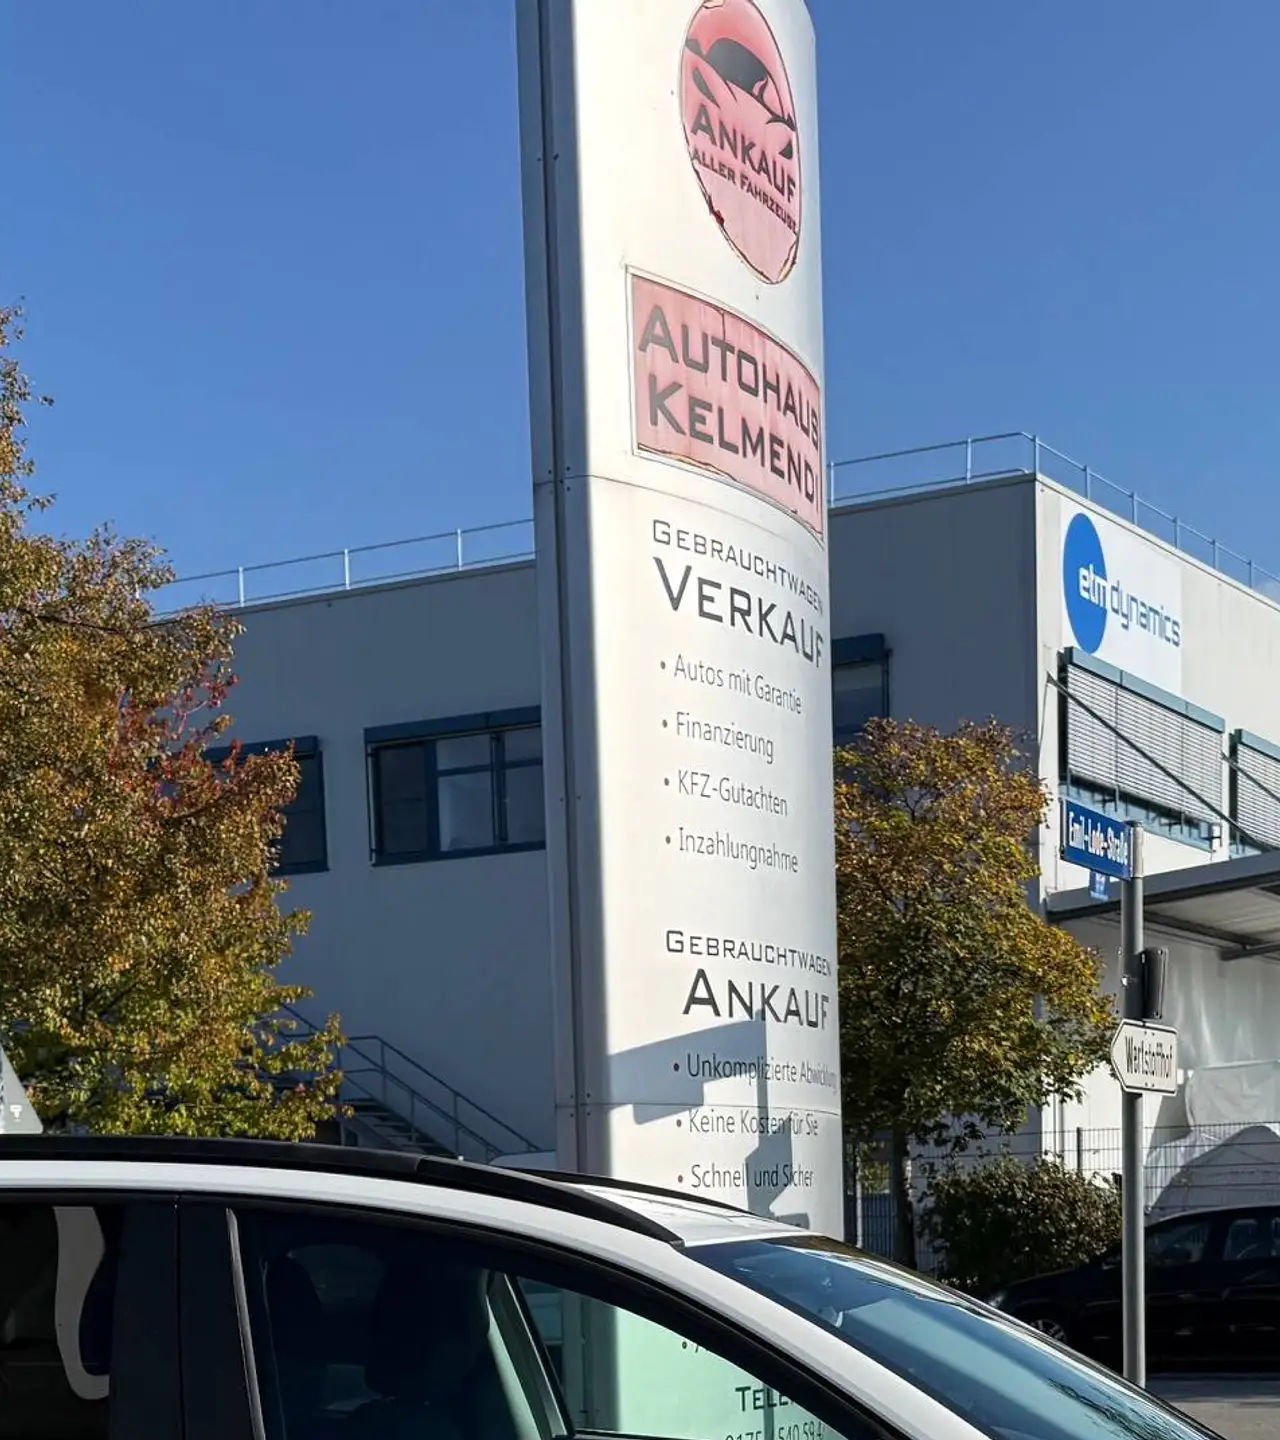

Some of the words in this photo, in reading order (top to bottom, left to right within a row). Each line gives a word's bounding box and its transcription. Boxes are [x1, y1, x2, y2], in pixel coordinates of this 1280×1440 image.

[691, 104, 796, 203] ANKAUF
[692, 147, 736, 185] ALLER
[638, 304, 819, 451] AUTOHAUS
[648, 374, 818, 513] KELMENDI
[653, 556, 823, 668] VERKAUF
[674, 654, 724, 687] Autos
[729, 670, 751, 696] mit
[755, 676, 802, 715] Garantie
[676, 711, 774, 764] Finanzierung
[678, 769, 788, 816] KFZ-Gutachten
[678, 827, 798, 873] Inzahlungnahme
[666, 930, 831, 977] GEBRAUCHTWAGEN
[683, 968, 829, 1030] ANKAUF
[687, 1053, 797, 1085] Unkomplizierte
[688, 1108, 735, 1133] Keine
[740, 1109, 788, 1134] Kosten
[805, 1113, 818, 1136] Sie
[691, 1163, 749, 1188] Schnell
[754, 1164, 779, 1187] und
[783, 1164, 813, 1187] Sicher
